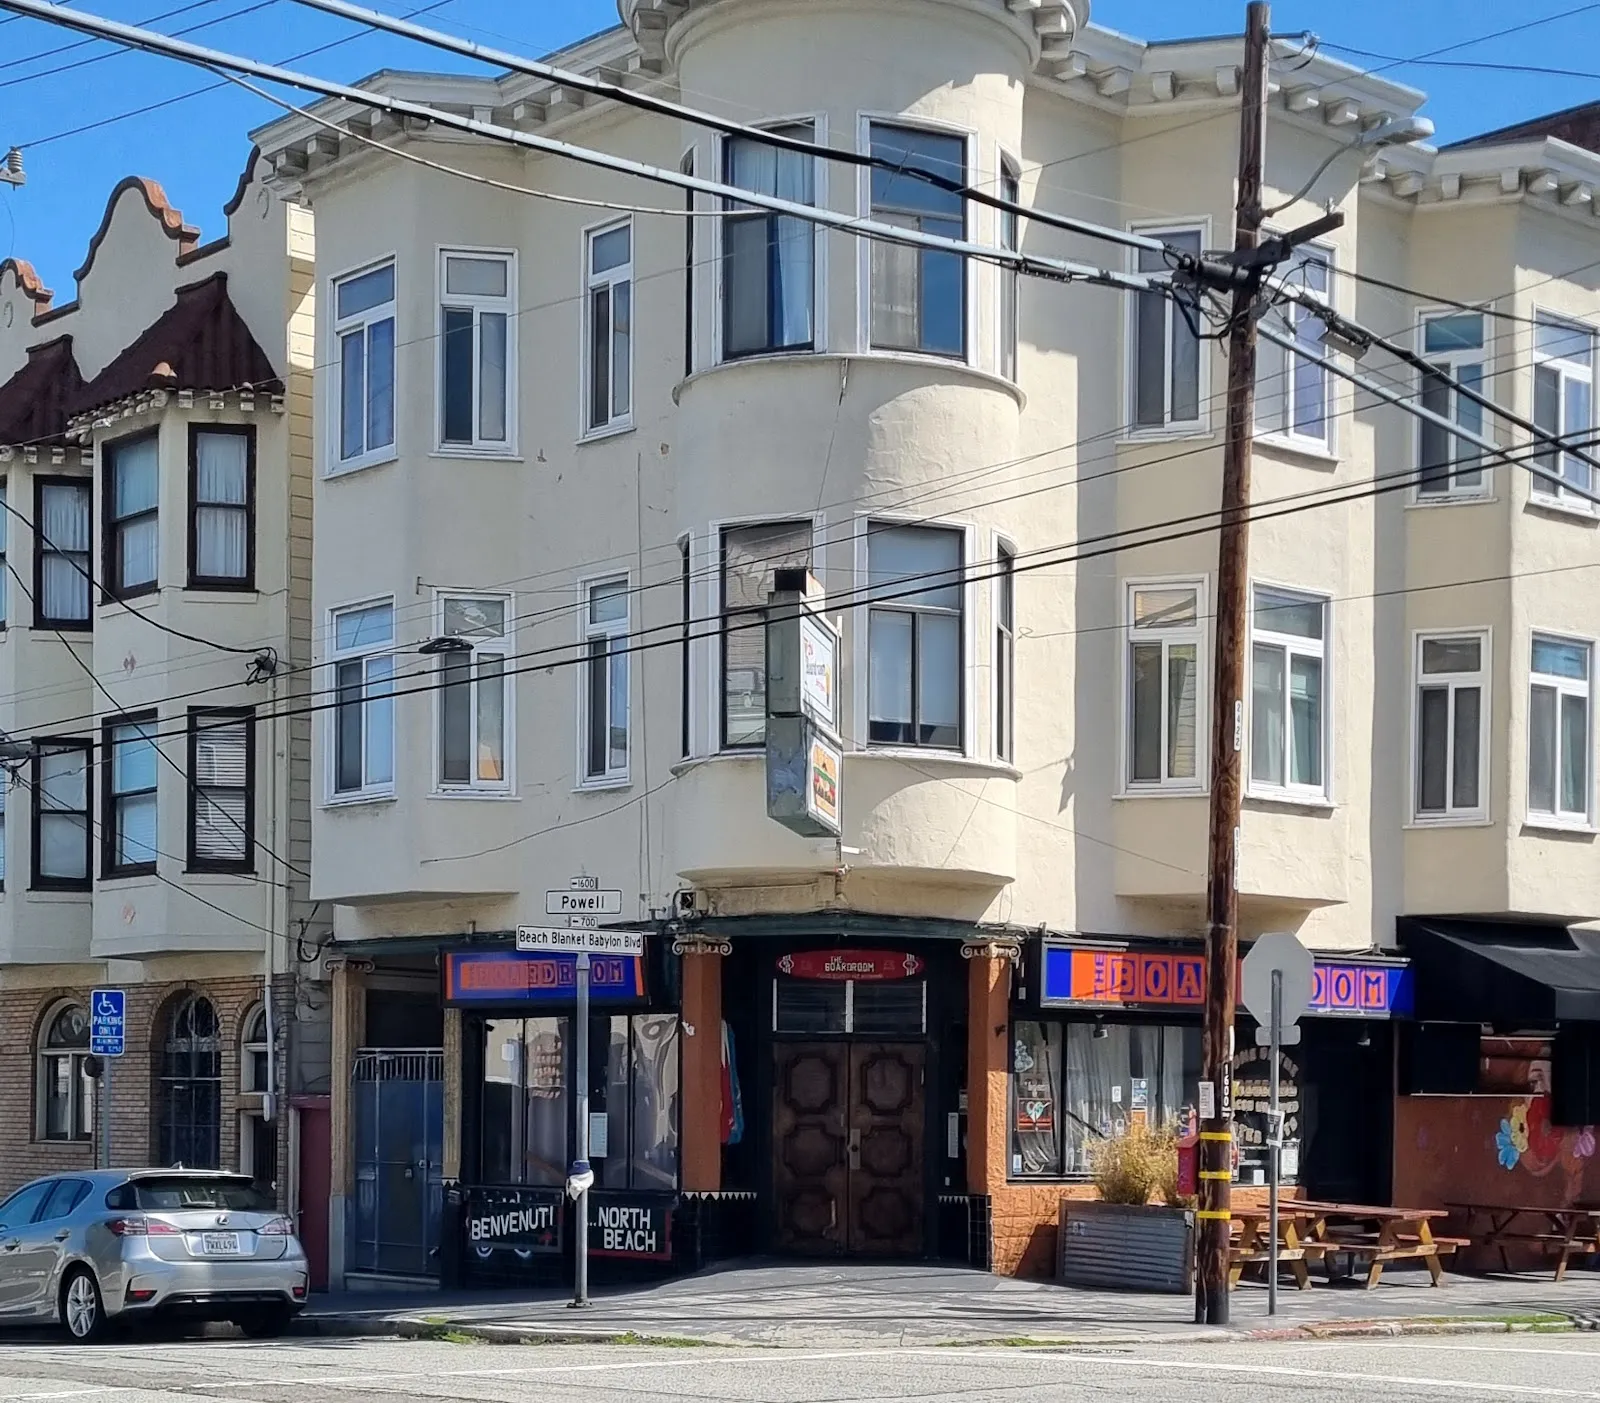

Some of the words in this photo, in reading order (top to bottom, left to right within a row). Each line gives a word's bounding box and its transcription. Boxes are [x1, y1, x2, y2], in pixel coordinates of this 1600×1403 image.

[561, 895, 605, 909] Powell
[581, 917, 596, 927] 700
[519, 930, 548, 943] Beach
[551, 931, 586, 946] Blanket
[589, 933, 622, 949] Babylon
[624, 935, 641, 949] Blvd
[830, 956, 842, 964] THE
[824, 962, 875, 972] BOARDROOM
[93, 1015, 123, 1026] PARKING
[98, 1026, 117, 1035] ONLY
[471, 1205, 554, 1241] BENVENUTI
[603, 1228, 656, 1253] BEACH
